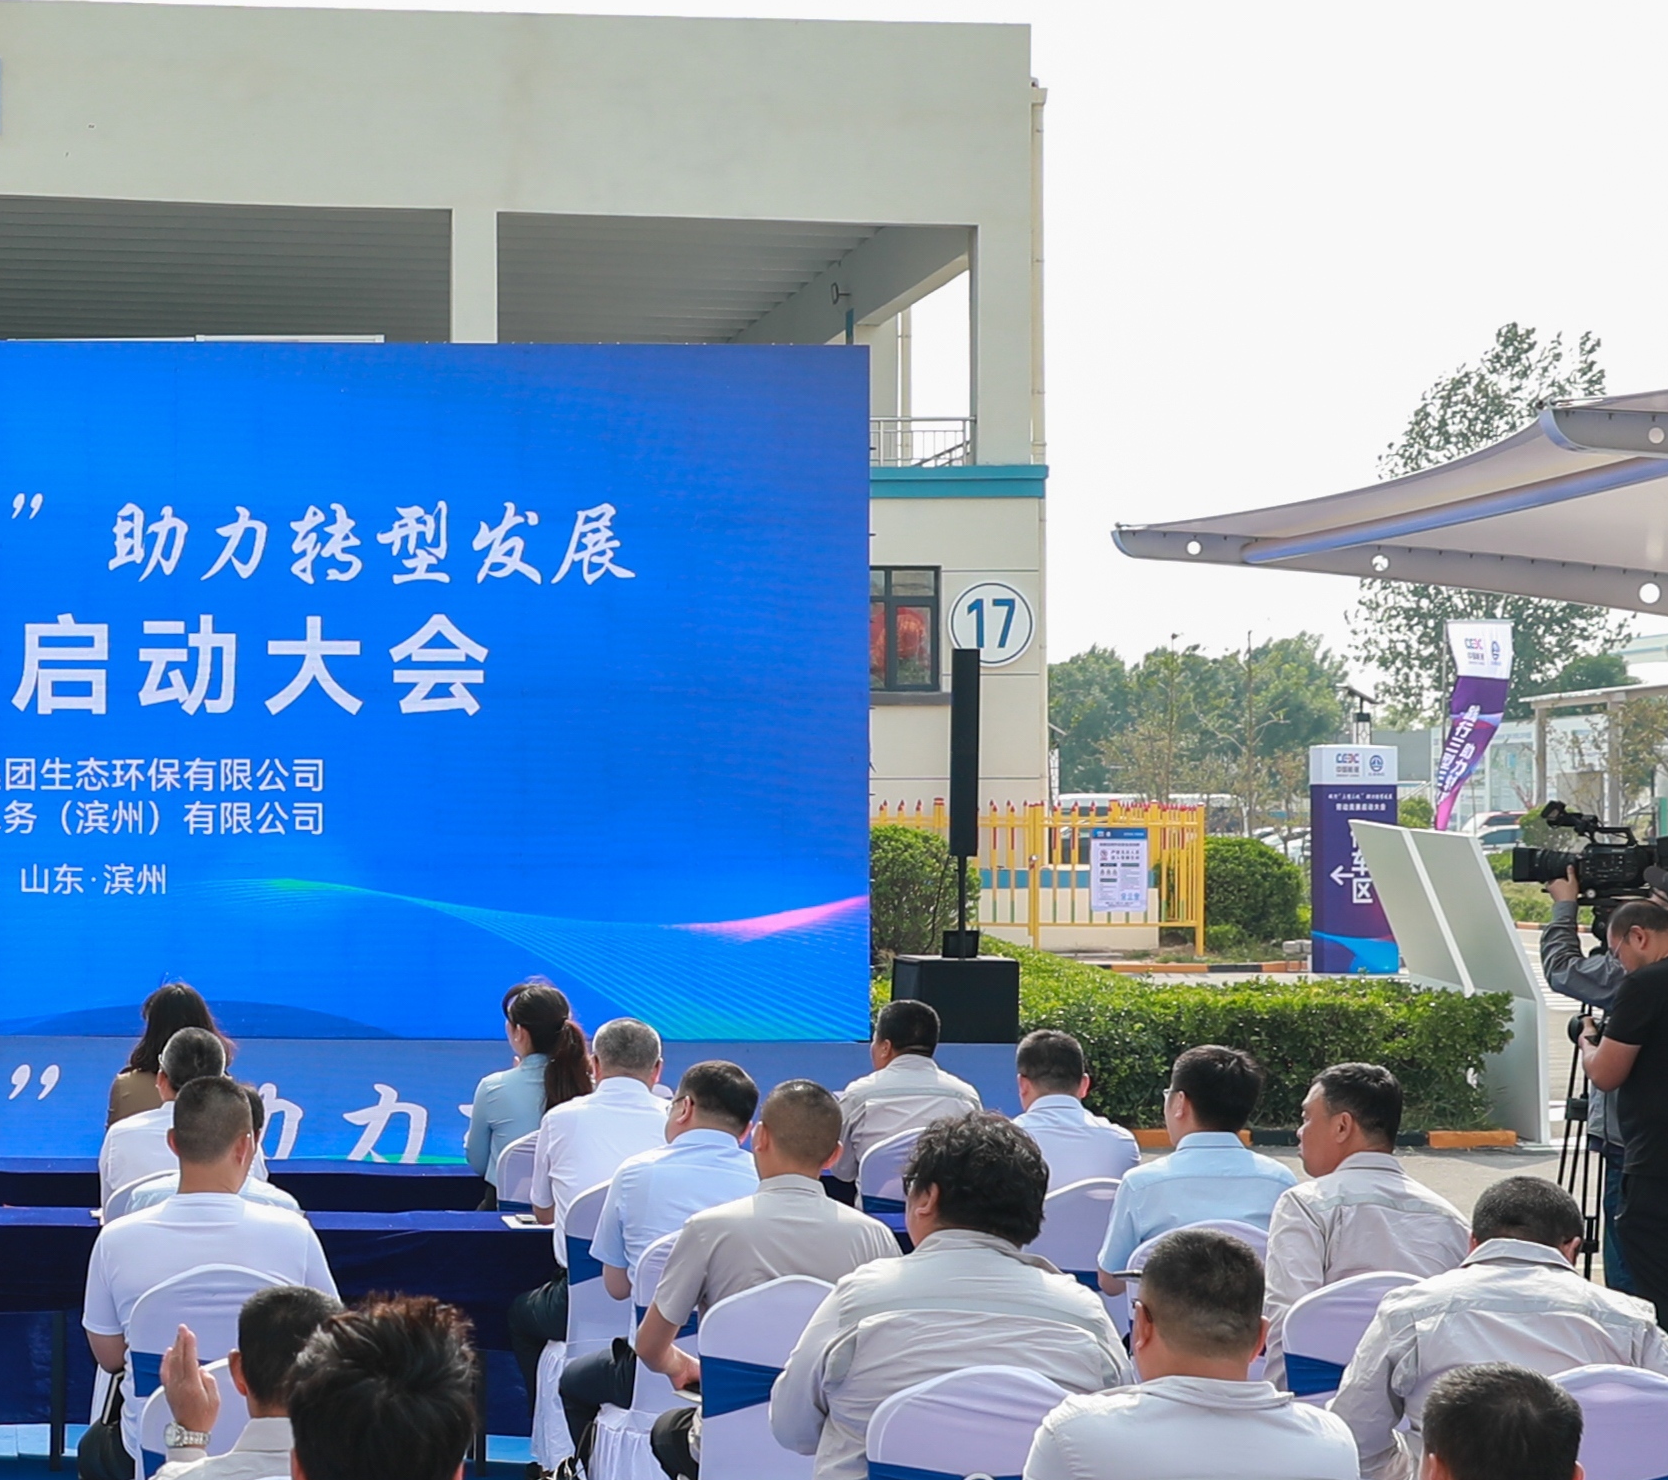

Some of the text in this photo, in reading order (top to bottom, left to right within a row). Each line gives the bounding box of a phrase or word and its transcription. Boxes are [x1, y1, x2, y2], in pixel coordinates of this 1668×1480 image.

[107, 499, 637, 586] 助力转型发展
[967, 598, 1015, 648] 17
